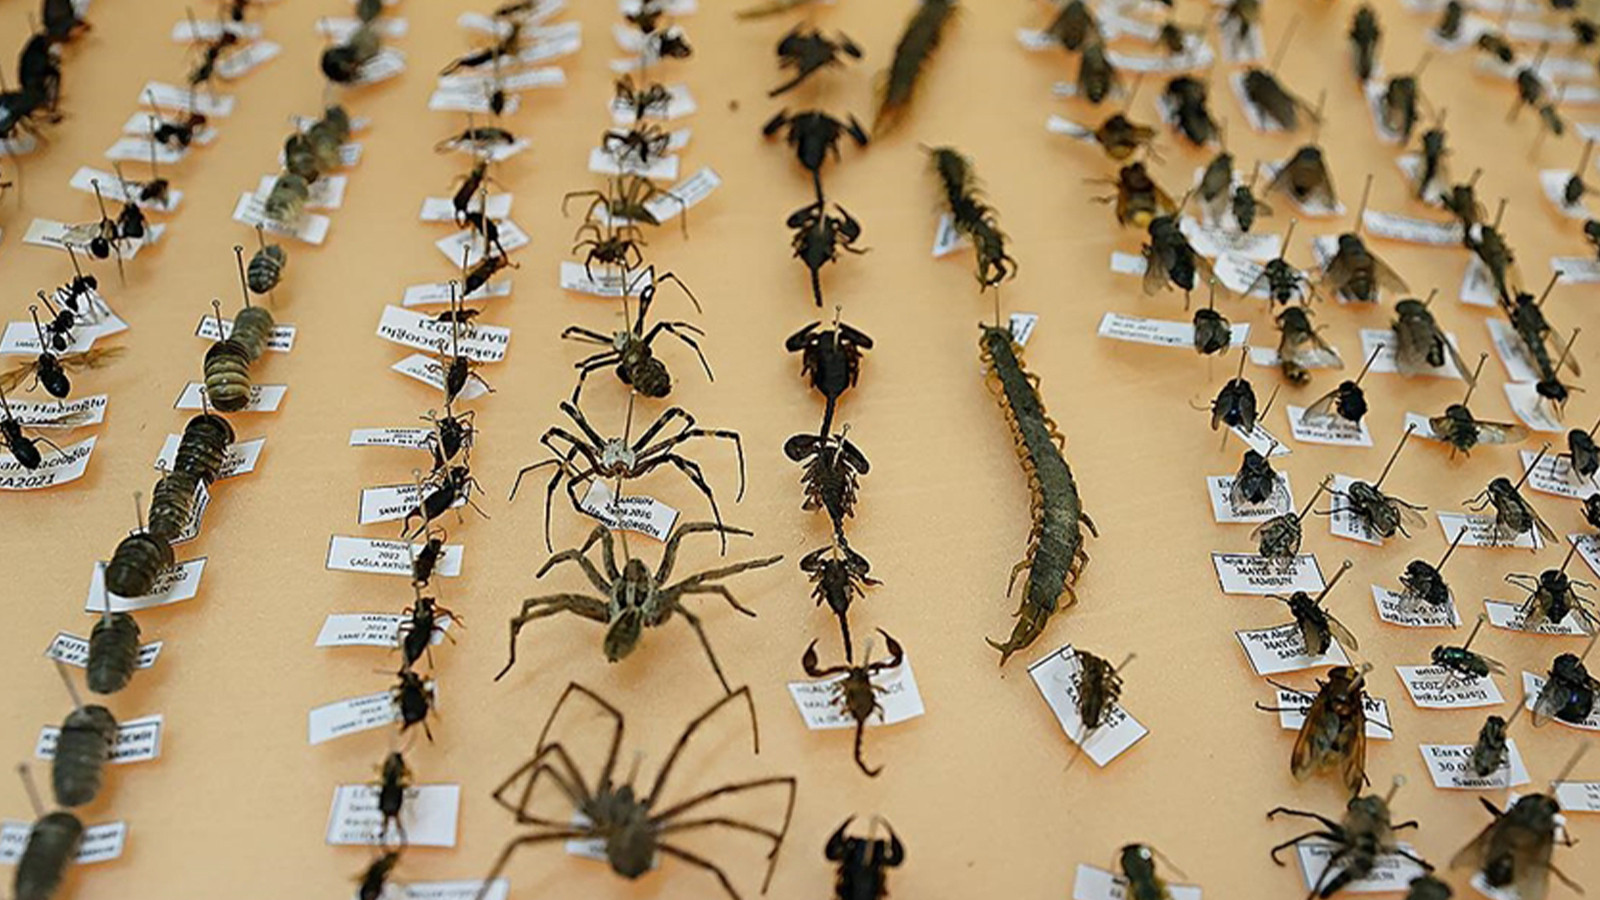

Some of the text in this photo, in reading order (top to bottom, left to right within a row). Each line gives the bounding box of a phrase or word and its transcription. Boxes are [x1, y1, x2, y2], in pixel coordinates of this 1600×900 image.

[418, 318, 509, 344] BAFR2021
[38, 447, 91, 470] acıoğlu
[618, 496, 655, 506] AMSUN
[1231, 506, 1277, 518] Samsun
[1248, 576, 1294, 586] SAMSUN
[1430, 746, 1462, 759] Esra
